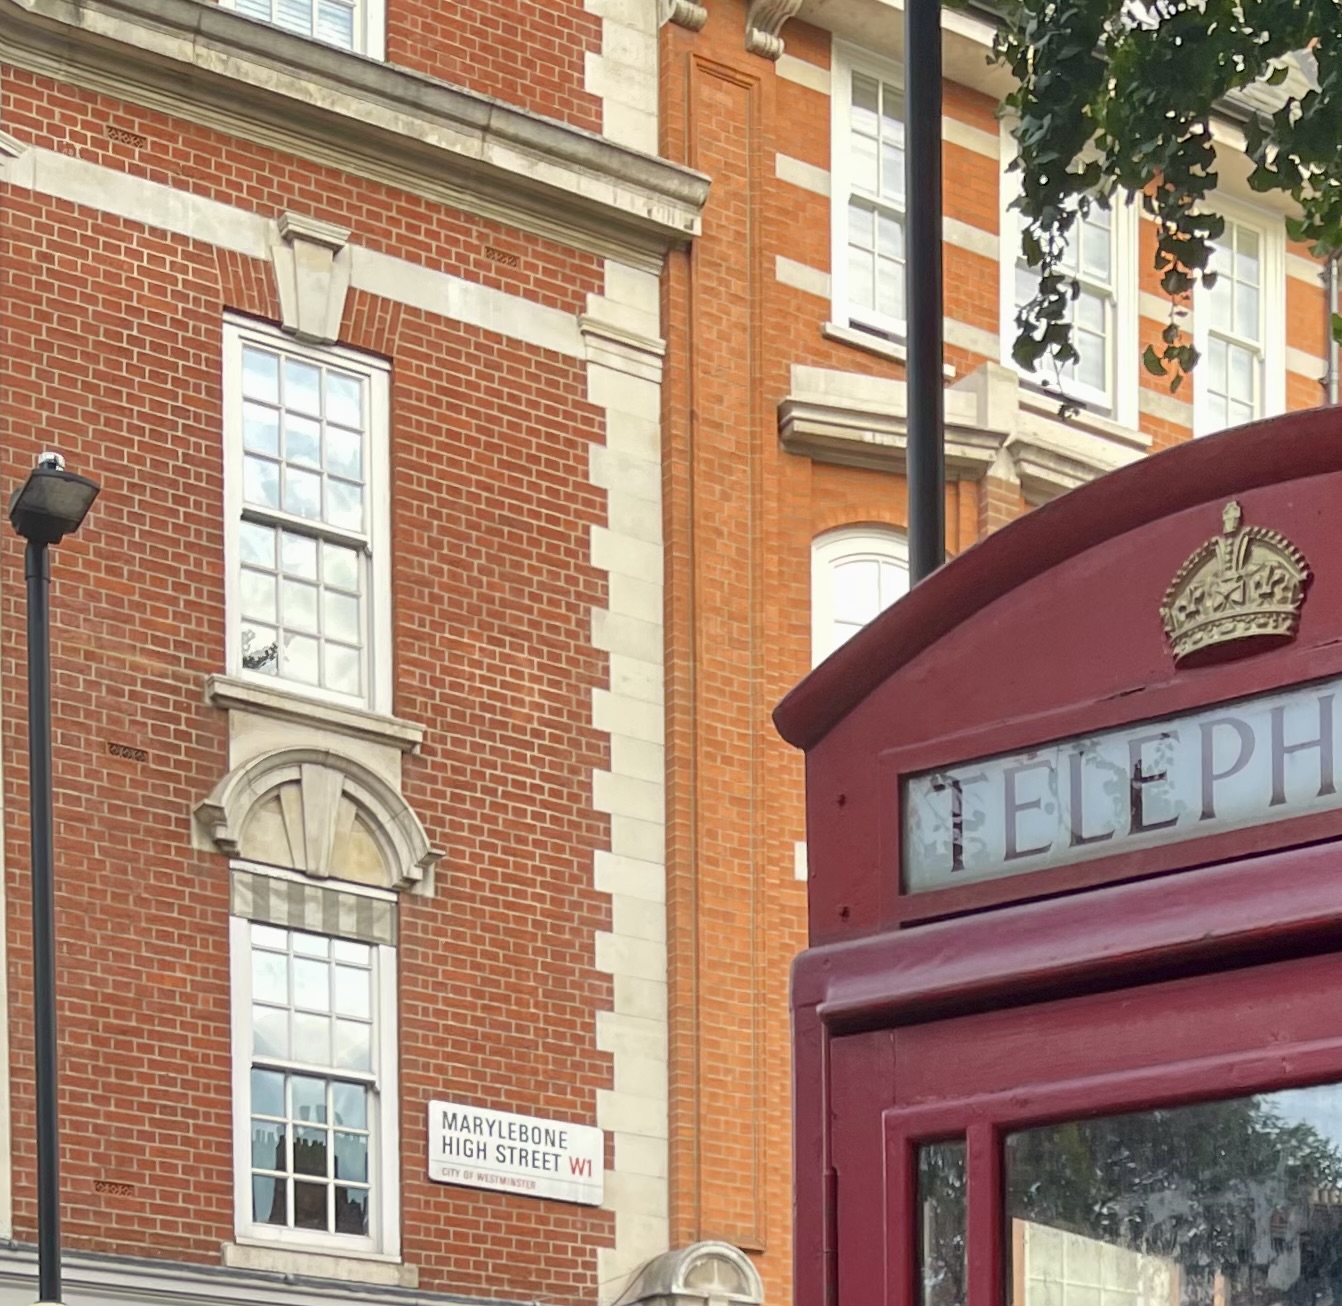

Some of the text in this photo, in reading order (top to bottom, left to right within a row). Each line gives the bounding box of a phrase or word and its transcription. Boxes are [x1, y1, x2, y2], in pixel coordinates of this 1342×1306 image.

[442, 1111, 568, 1150] MARYLEBONE
[442, 1135, 592, 1177] HIGH STREET W1
[442, 1168, 536, 1190] CITY OF WESTMINSTER
